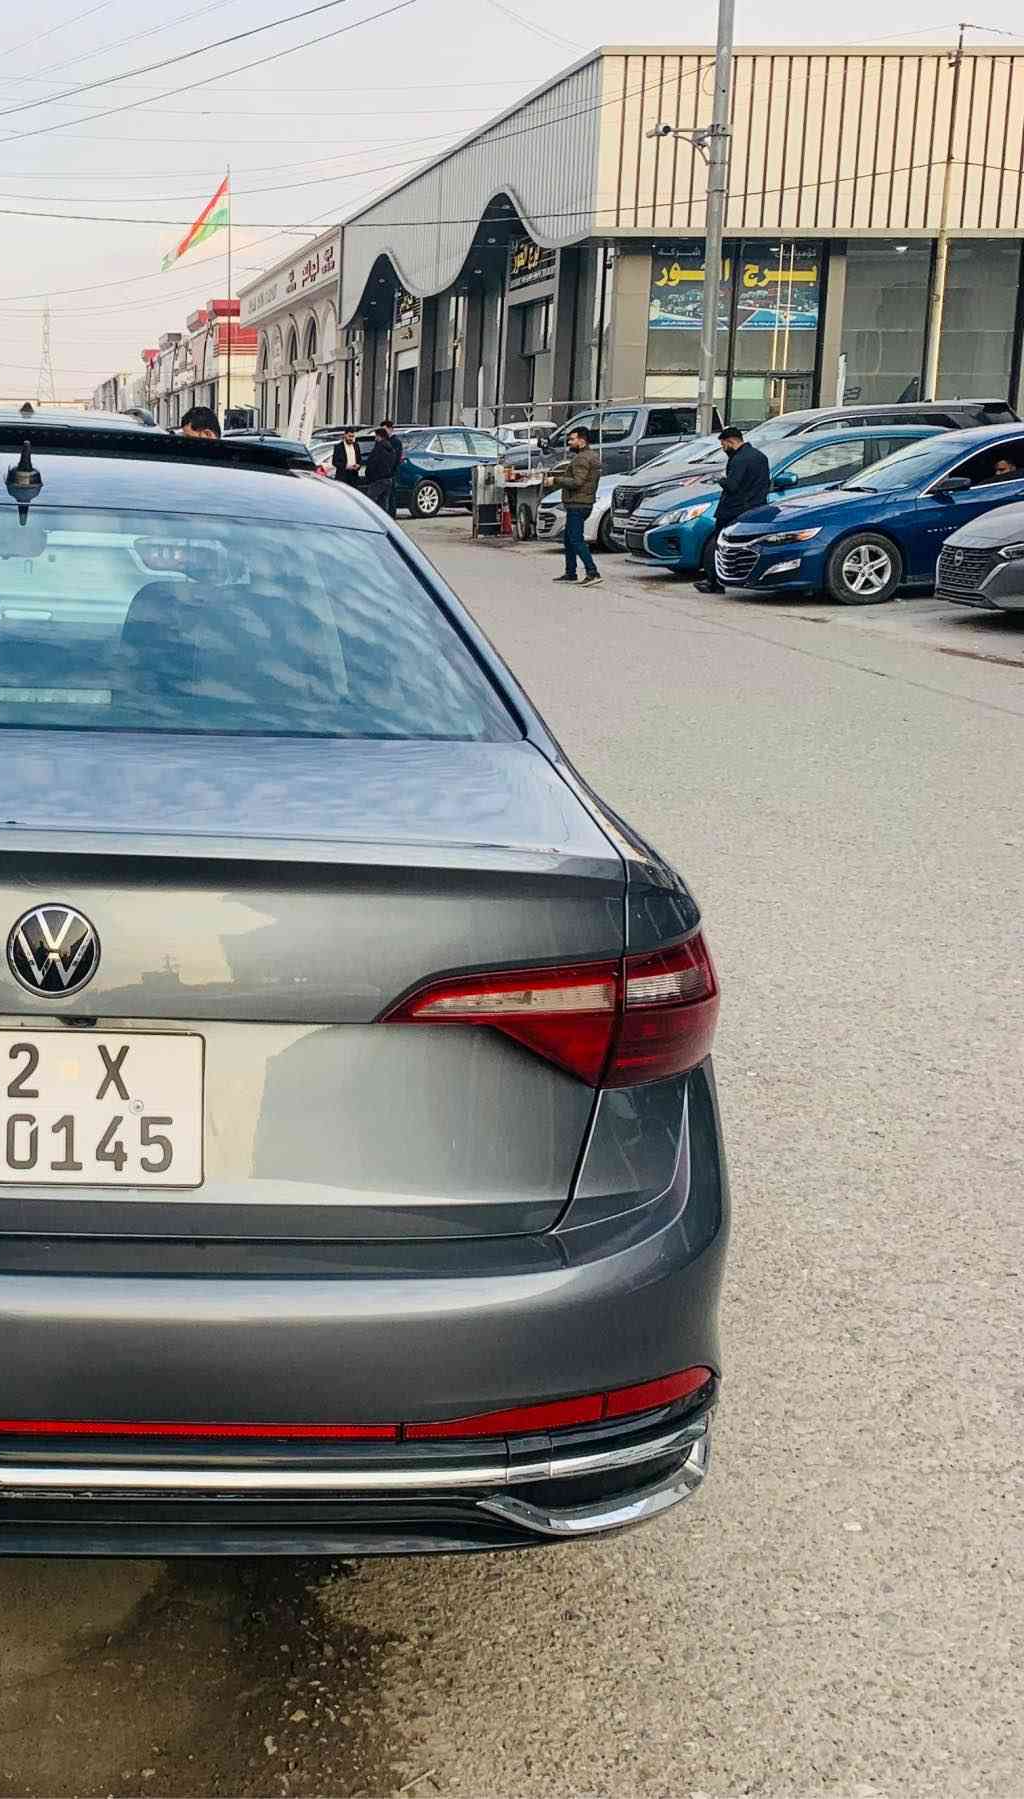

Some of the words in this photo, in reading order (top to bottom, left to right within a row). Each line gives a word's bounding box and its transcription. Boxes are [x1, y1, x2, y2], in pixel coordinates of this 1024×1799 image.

[655, 257, 730, 287] اور
[743, 264, 817, 288] برج
[95, 1044, 130, 1101] X
